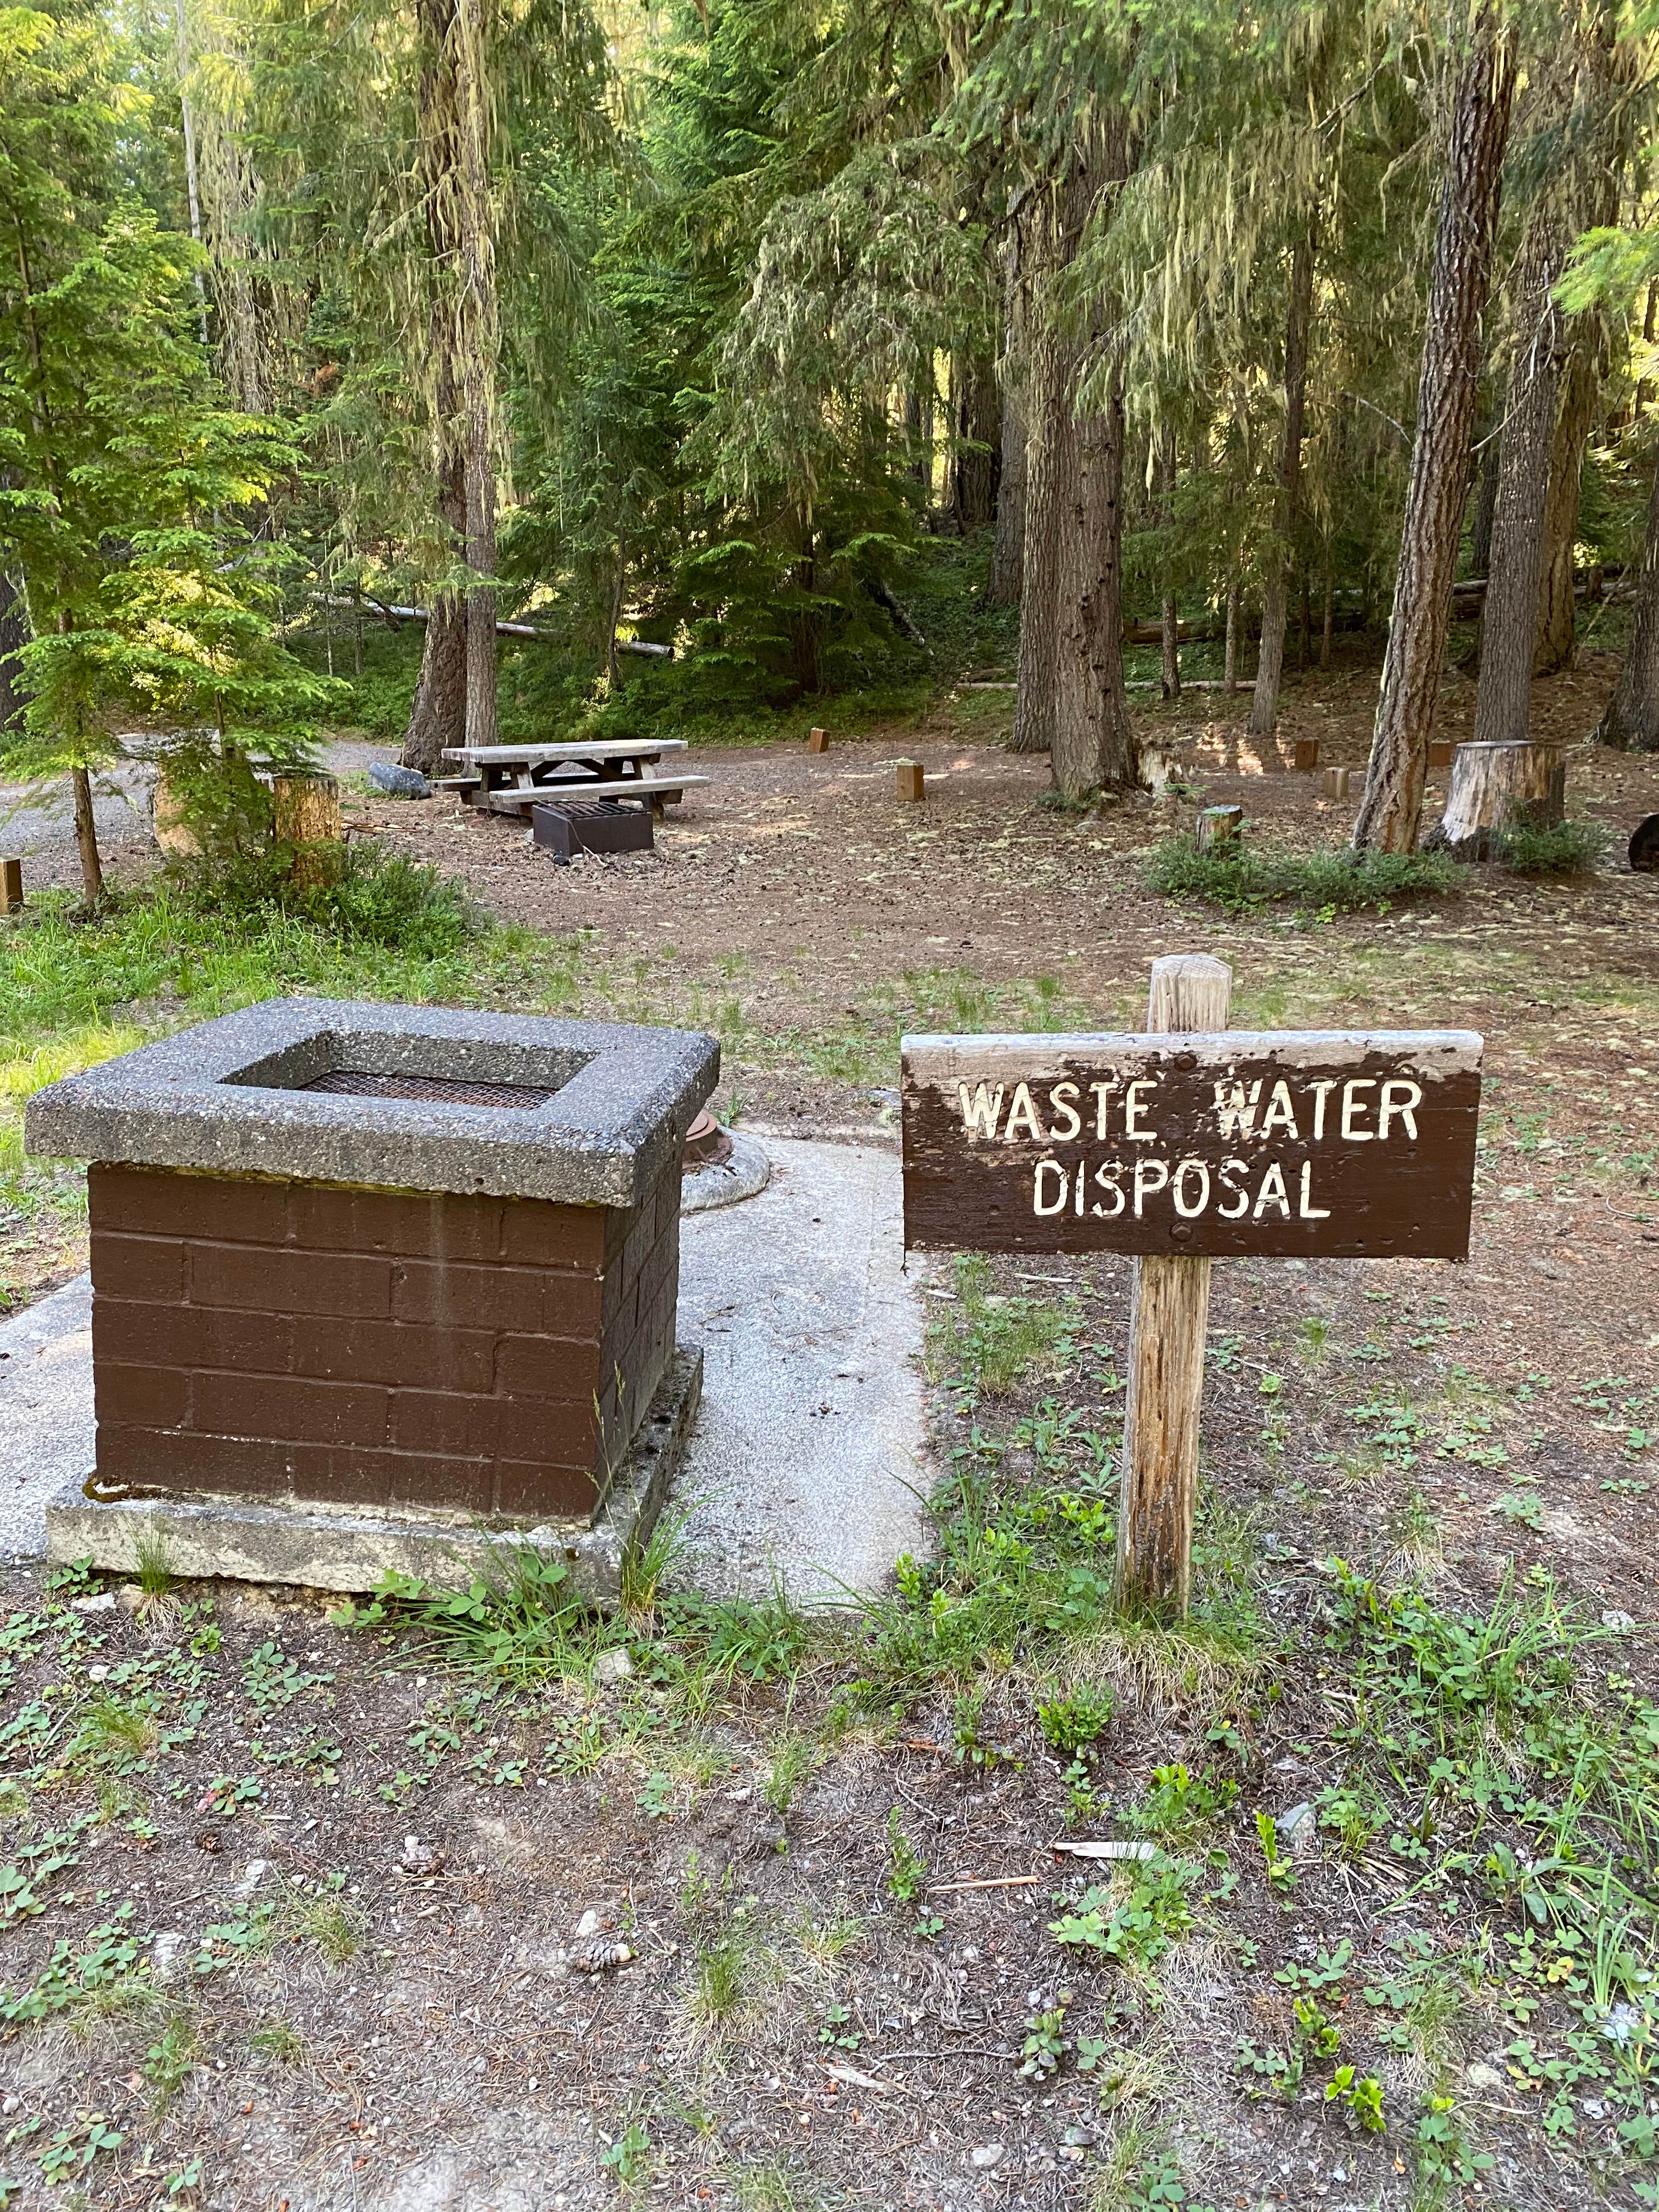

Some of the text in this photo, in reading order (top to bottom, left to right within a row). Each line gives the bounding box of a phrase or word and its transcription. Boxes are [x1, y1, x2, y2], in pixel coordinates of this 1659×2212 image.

[958, 1079, 1423, 1141] WASTE WATER
[1034, 1159, 1331, 1218] DISPOSAL
